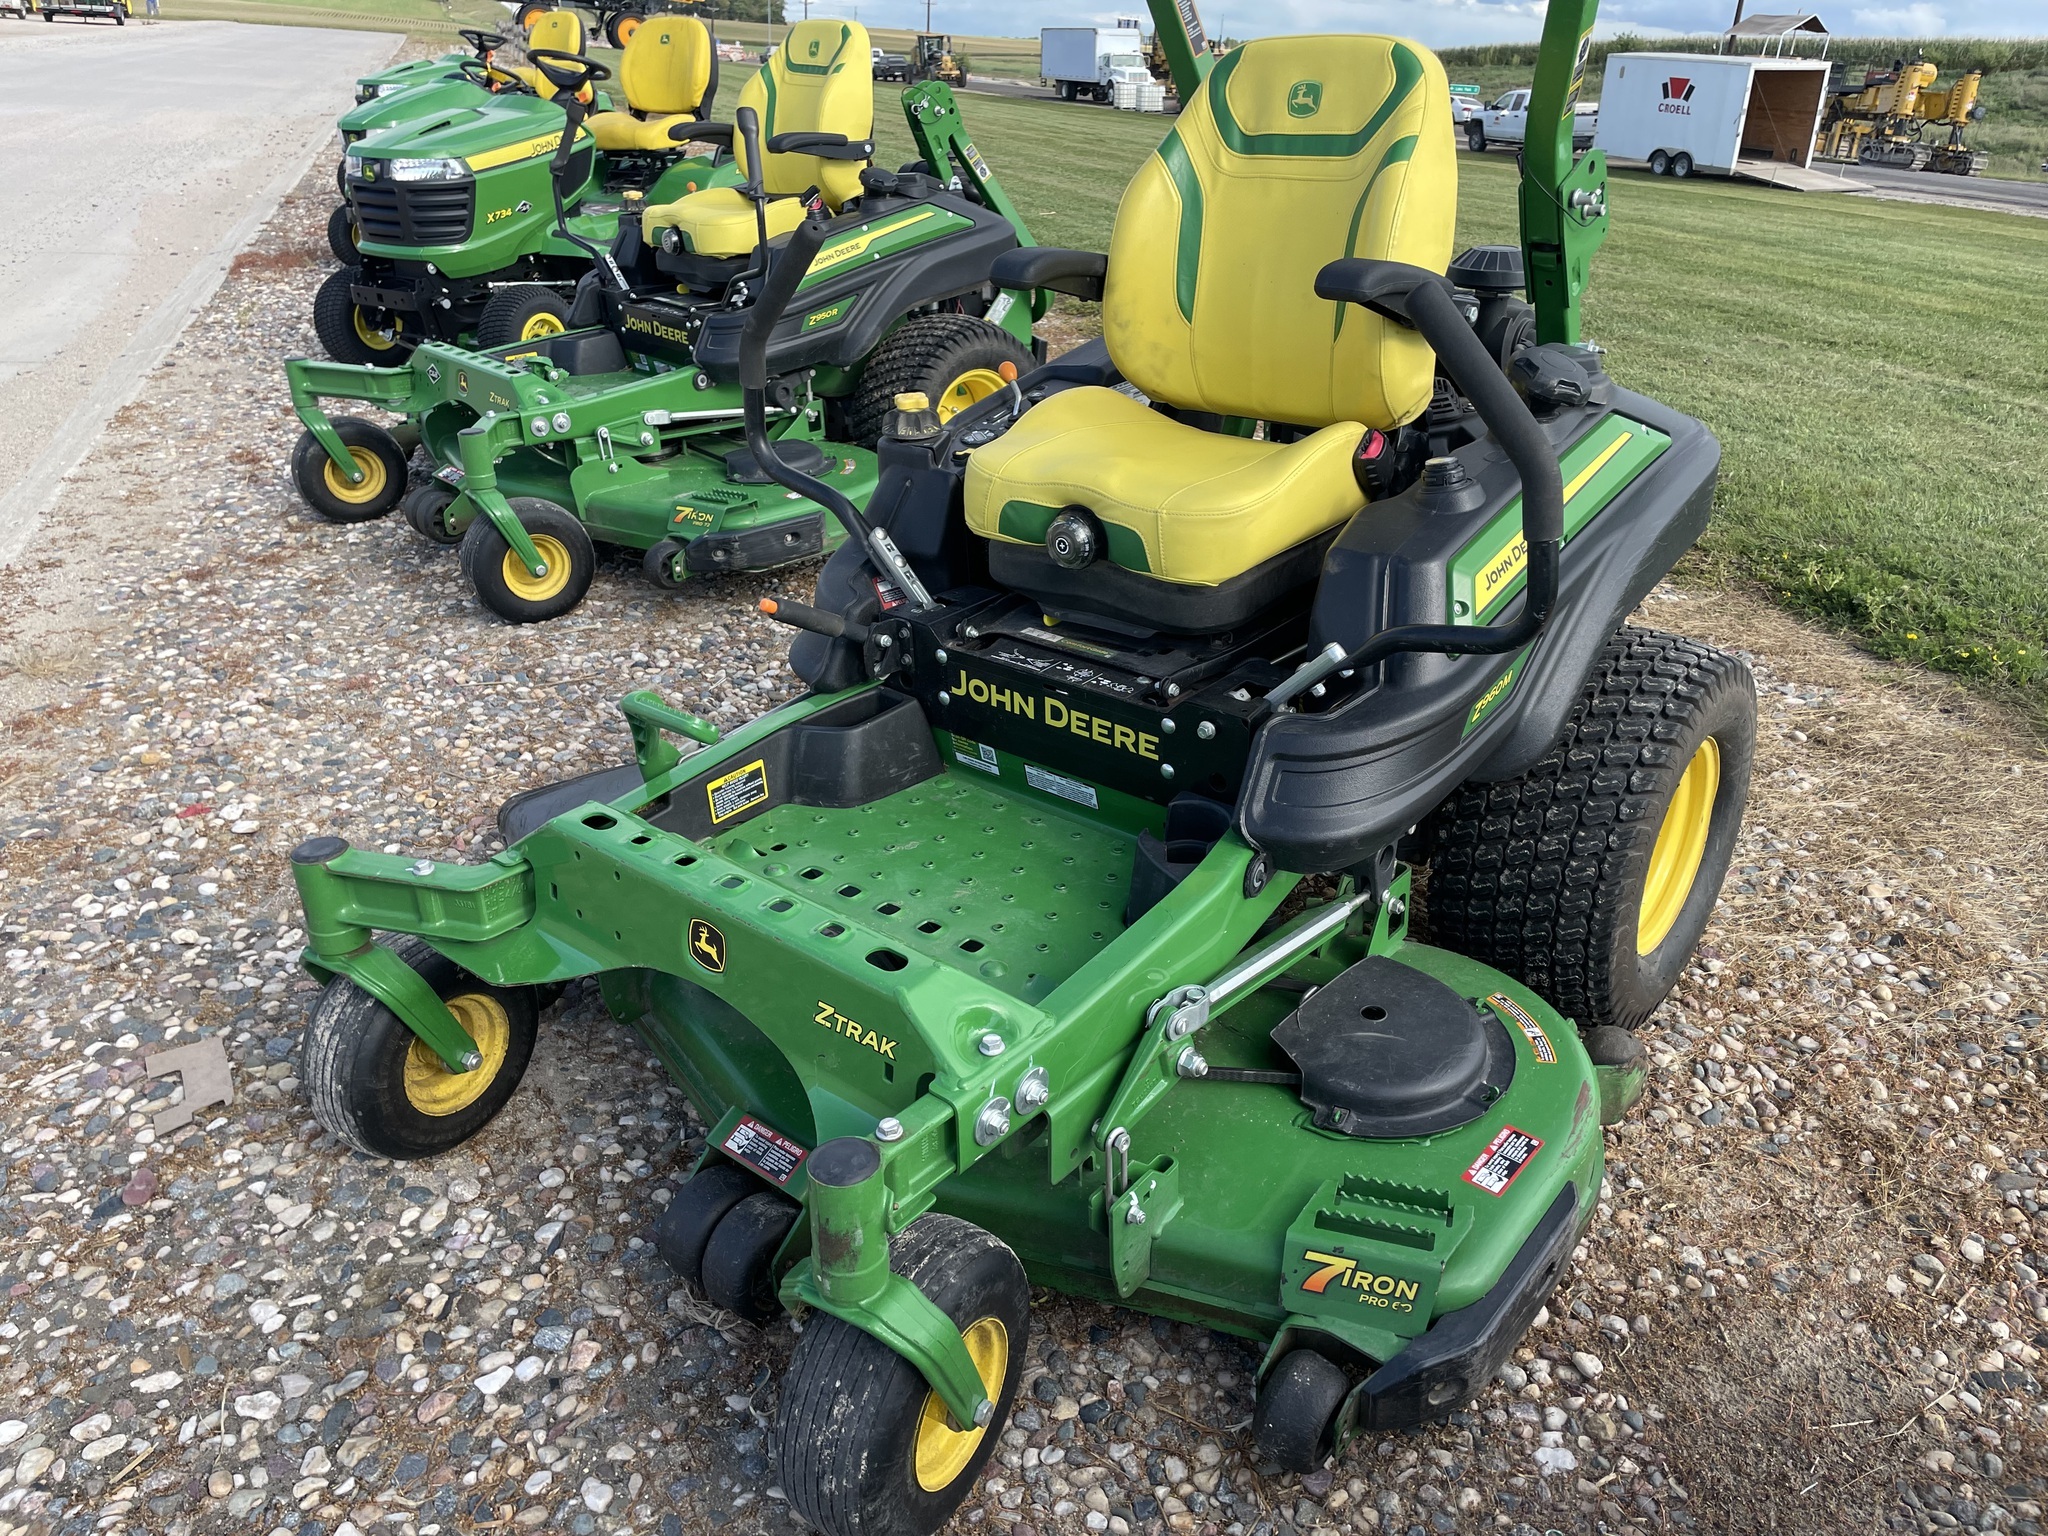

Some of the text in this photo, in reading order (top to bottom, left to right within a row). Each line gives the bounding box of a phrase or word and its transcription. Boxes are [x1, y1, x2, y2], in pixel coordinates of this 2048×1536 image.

[1658, 103, 1691, 115] CROELL
[530, 138, 554, 157] JOHN
[486, 208, 513, 225] X734
[814, 242, 862, 267] JOHN DEERE
[808, 308, 838, 326] Z950R
[625, 313, 690, 345] JOHN DEERE
[489, 391, 510, 408] ZTRAK
[1485, 557, 1514, 591] JOHN
[1471, 668, 1514, 724] Z960M
[950, 669, 1036, 720] JOHN
[1044, 696, 1160, 761] DEERE
[727, 769, 746, 781] CAUTION
[814, 1000, 899, 1062] ZTRAK
[753, 1123, 774, 1139] DANGER
[781, 1140, 803, 1157] PELIGRO
[1358, 1294, 1389, 1308] PRO
